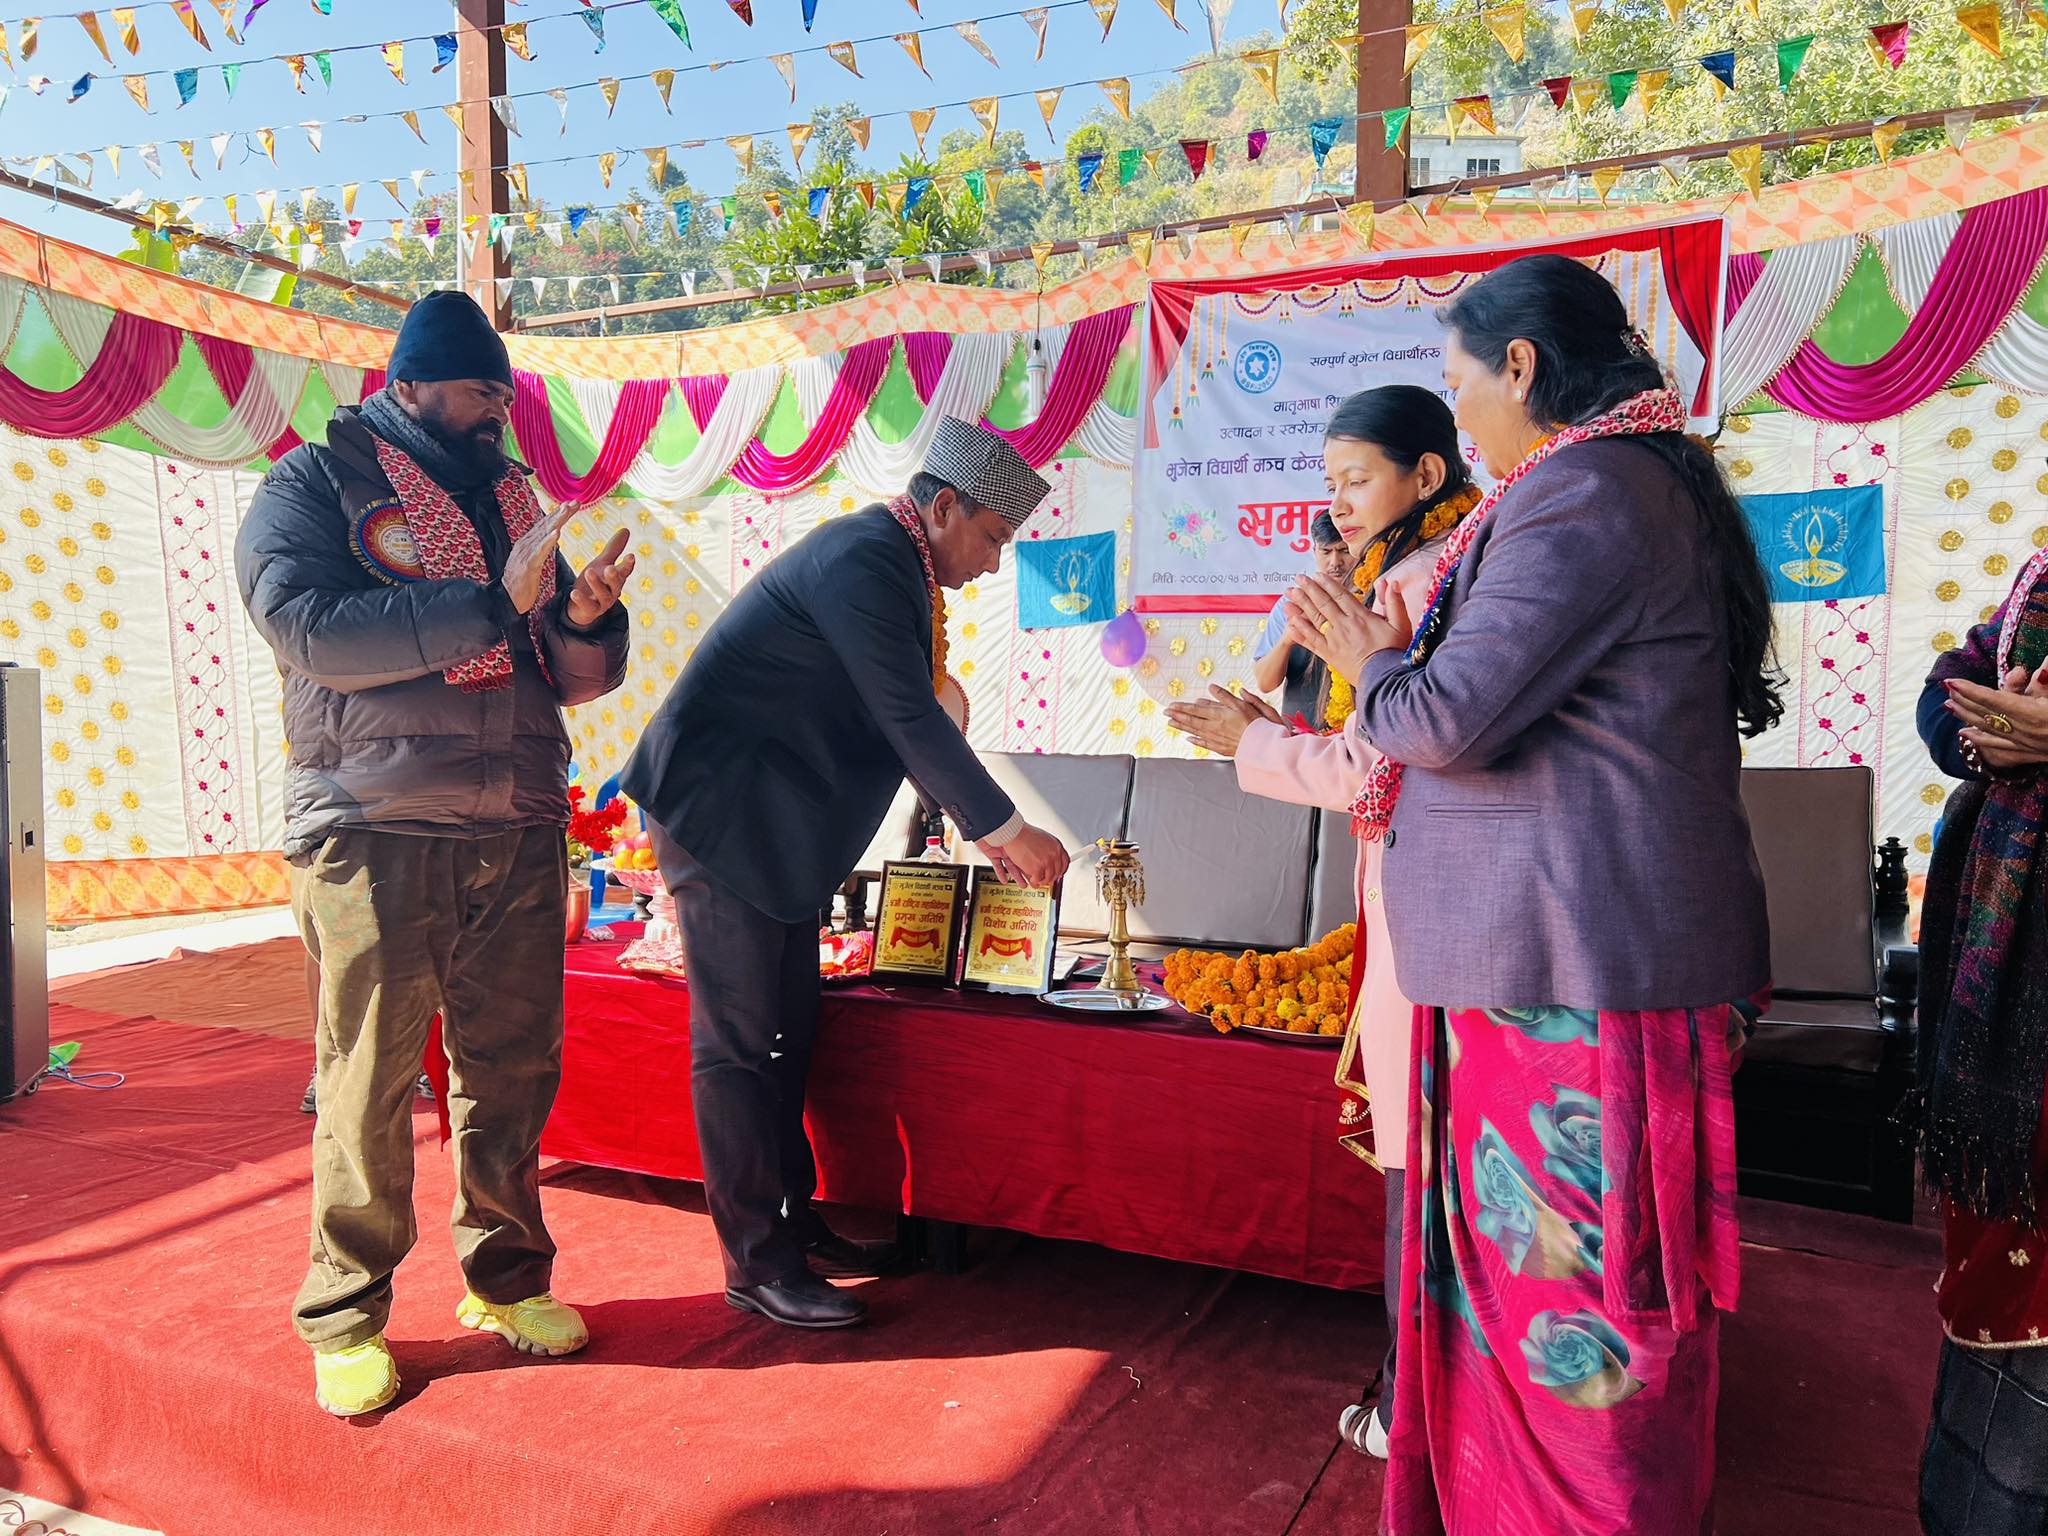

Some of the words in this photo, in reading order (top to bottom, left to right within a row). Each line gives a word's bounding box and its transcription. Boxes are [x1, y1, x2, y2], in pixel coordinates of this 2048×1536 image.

[1273, 398, 1321, 415] मातृभाषा
[1219, 426, 1263, 440] उत्पादन
[1266, 425, 1275, 437] र
[1166, 457, 1202, 482] भुजेल
[1207, 453, 1250, 476] विद्यार्थी
[1238, 500, 1333, 553] समु
[919, 912, 945, 923] अतिथि
[1010, 920, 1038, 931] अतिथि
